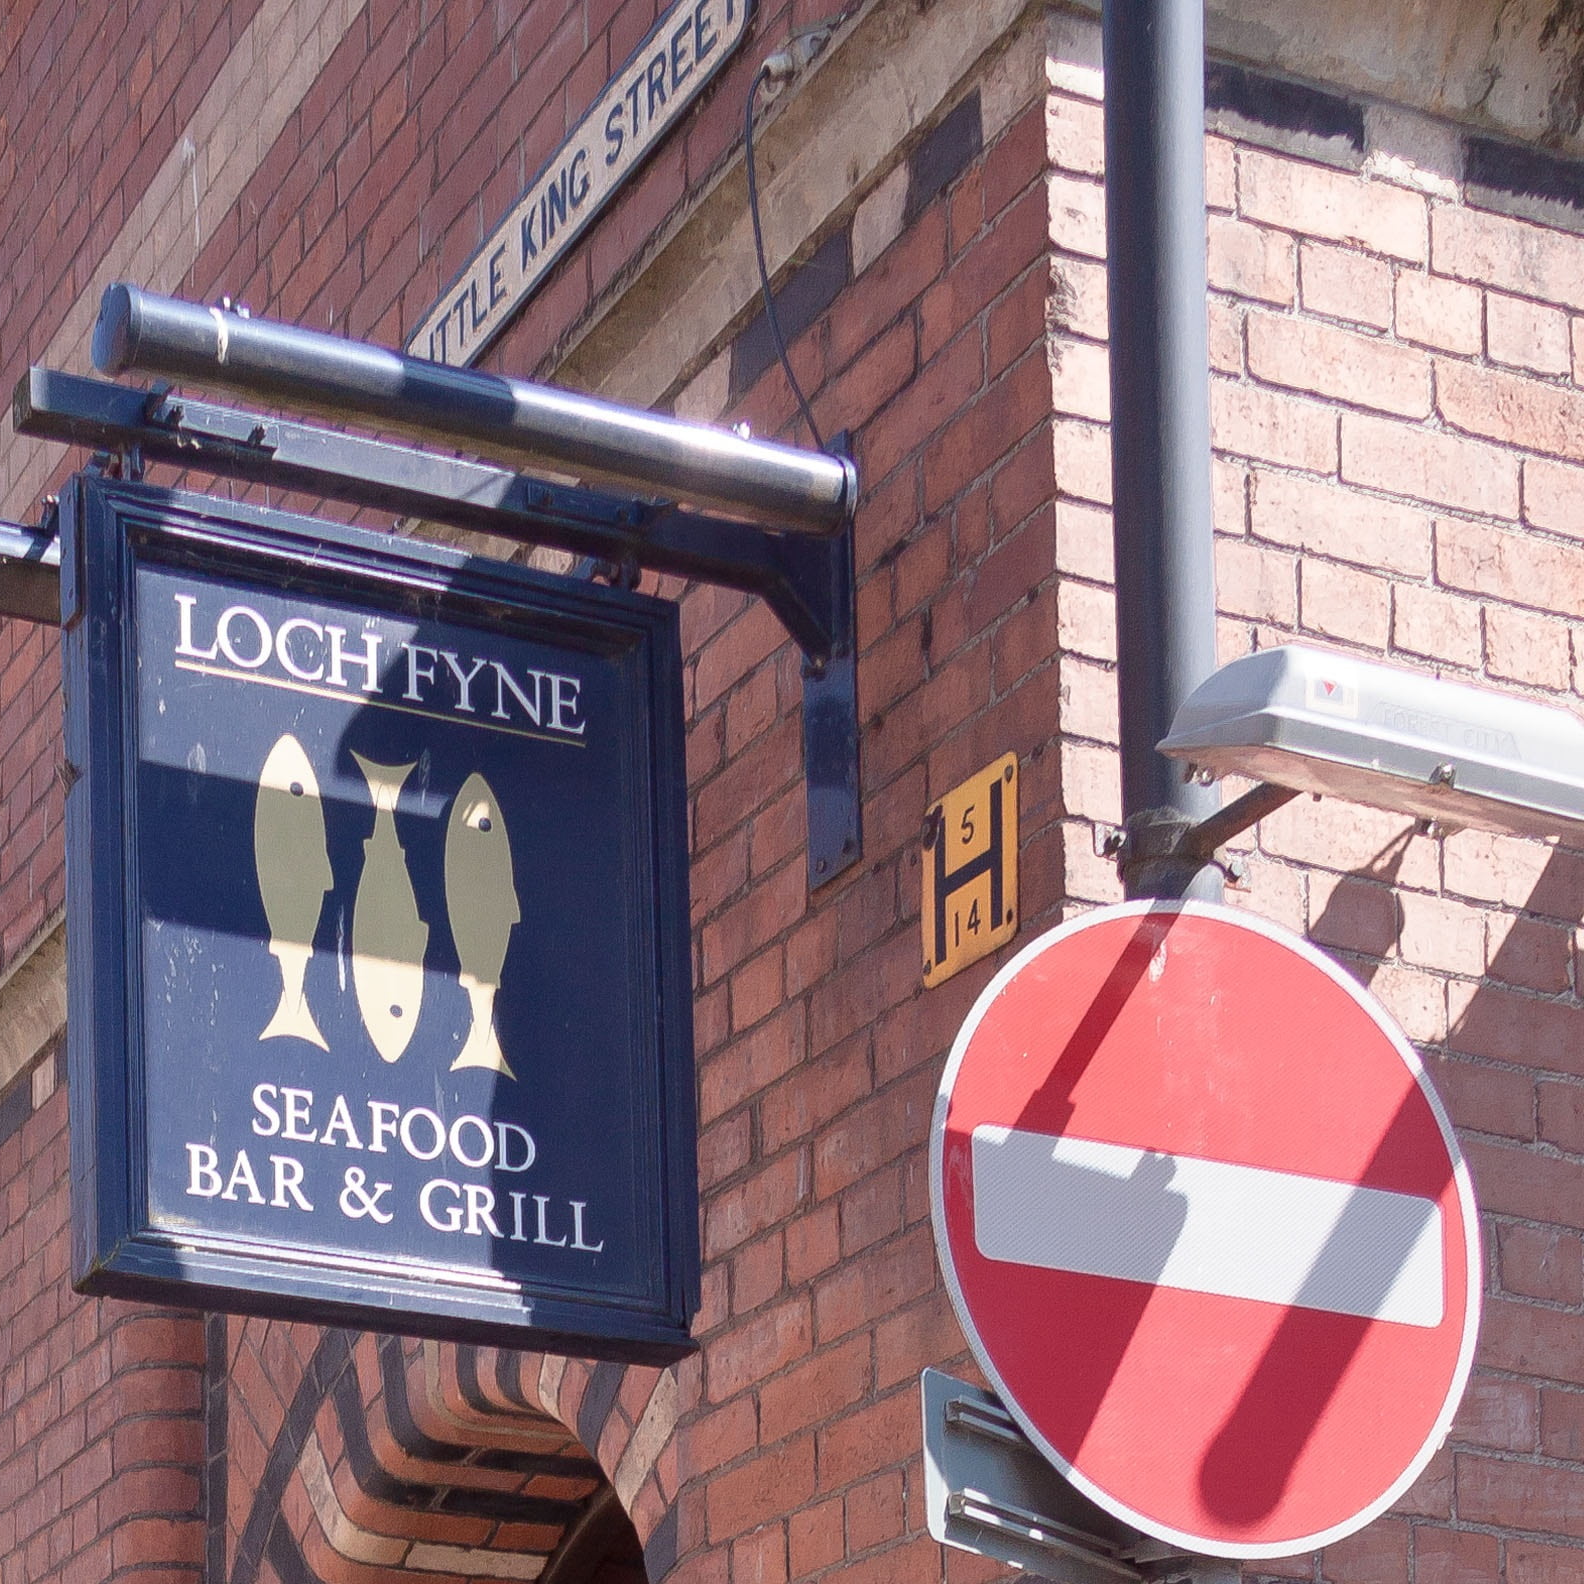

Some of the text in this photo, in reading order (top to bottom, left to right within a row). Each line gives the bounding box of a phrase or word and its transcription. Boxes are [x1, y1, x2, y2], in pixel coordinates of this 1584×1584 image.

[426, 240, 508, 363] ITTLE
[520, 149, 591, 272] KING
[173, 592, 587, 736] LOCH FYNE
[934, 778, 1004, 967] H
[960, 804, 976, 845] 5
[954, 898, 982, 948] 14
[251, 1083, 537, 1174] SEAFOOD
[185, 1141, 605, 1253] BAR & GRILL
